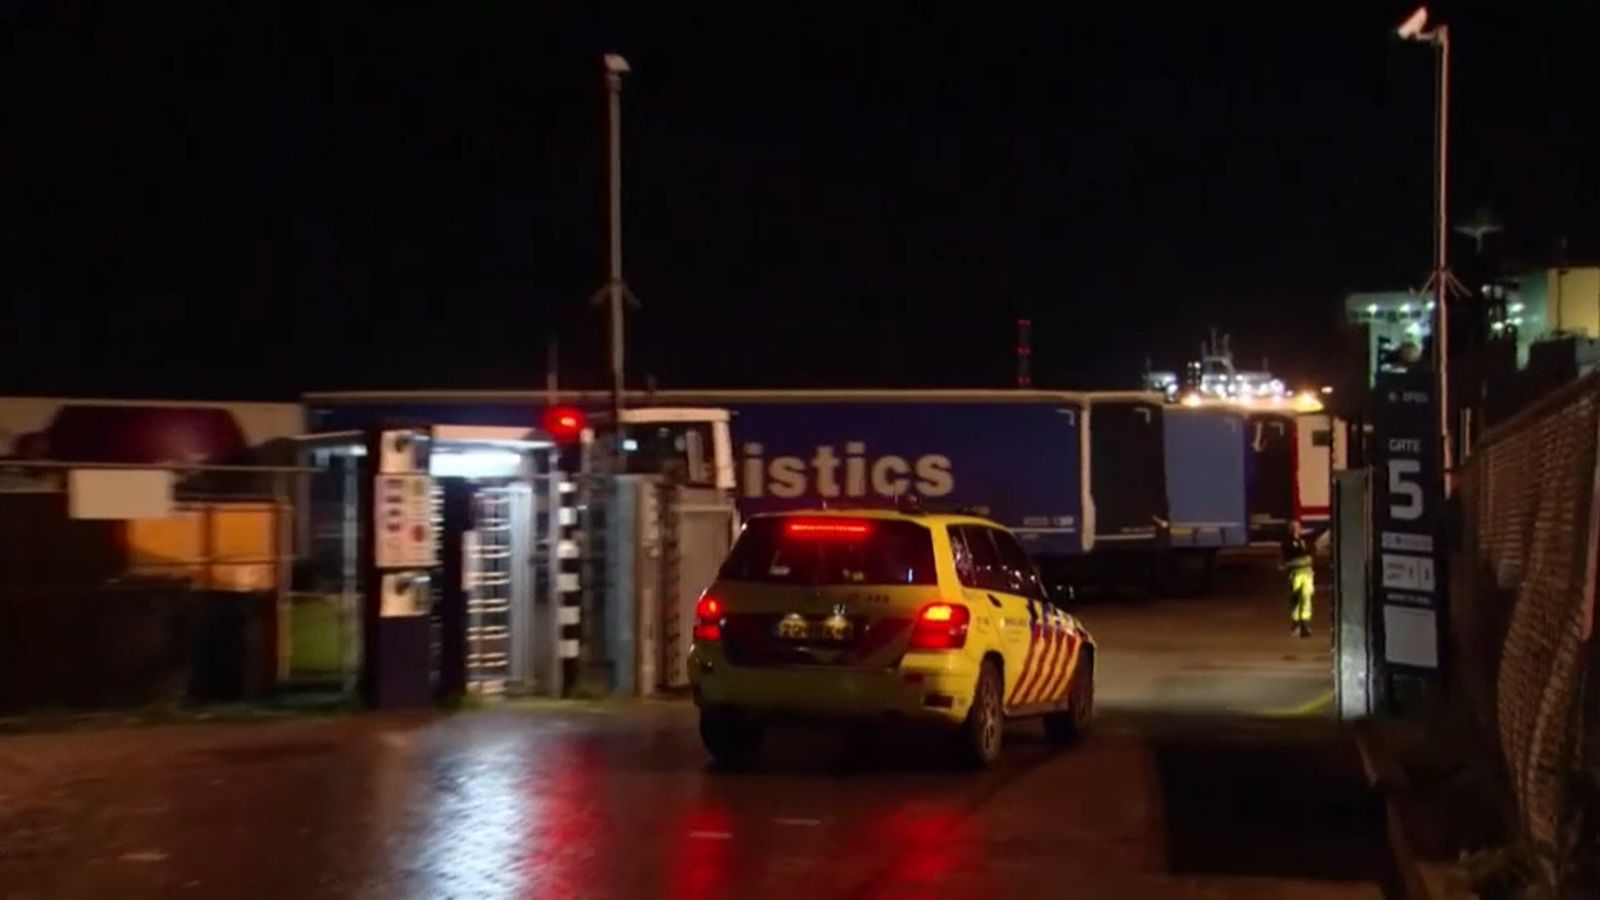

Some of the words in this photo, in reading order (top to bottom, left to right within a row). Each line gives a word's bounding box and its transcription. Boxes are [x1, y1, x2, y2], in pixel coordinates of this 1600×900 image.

[743, 440, 954, 498] istics
[1388, 437, 1421, 453] GATE
[1388, 459, 1424, 520] 5
